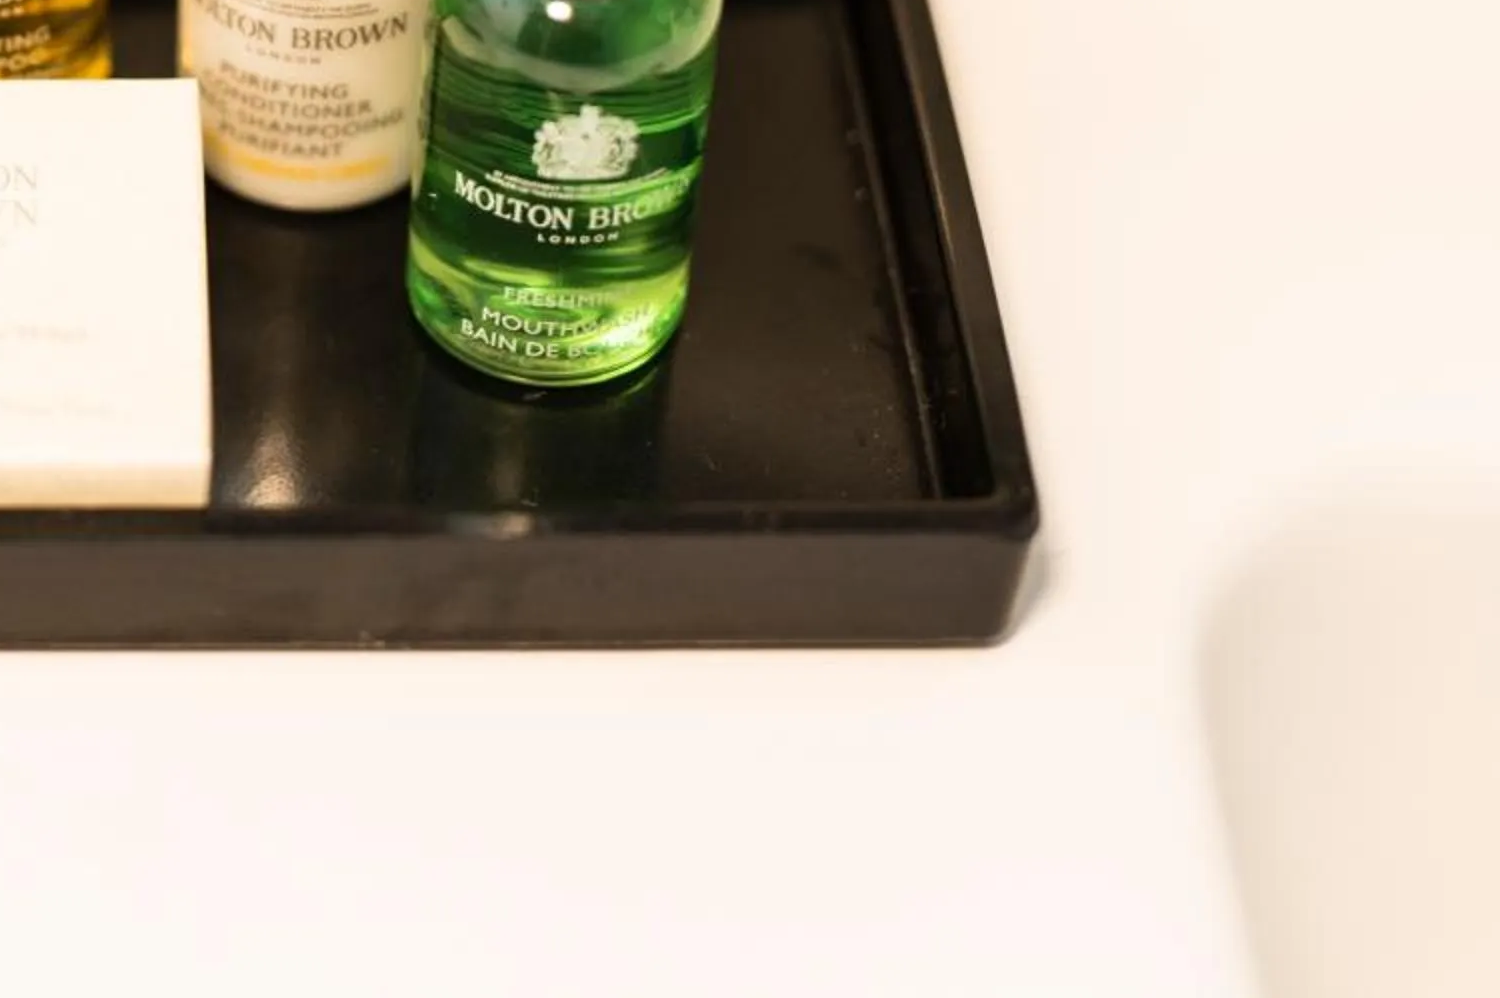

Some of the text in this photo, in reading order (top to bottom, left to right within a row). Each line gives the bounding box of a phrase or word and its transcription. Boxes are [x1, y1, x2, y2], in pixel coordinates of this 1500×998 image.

[291, 12, 408, 51] BROWN
[218, 58, 348, 100] PURIFYING
[455, 169, 575, 231] MOLTON
[537, 231, 620, 245] LONDON
[502, 285, 624, 310] FRESHMI
[461, 318, 517, 352] BAIN
[525, 339, 558, 358] DE
[482, 302, 654, 338] MOUTHWSH
